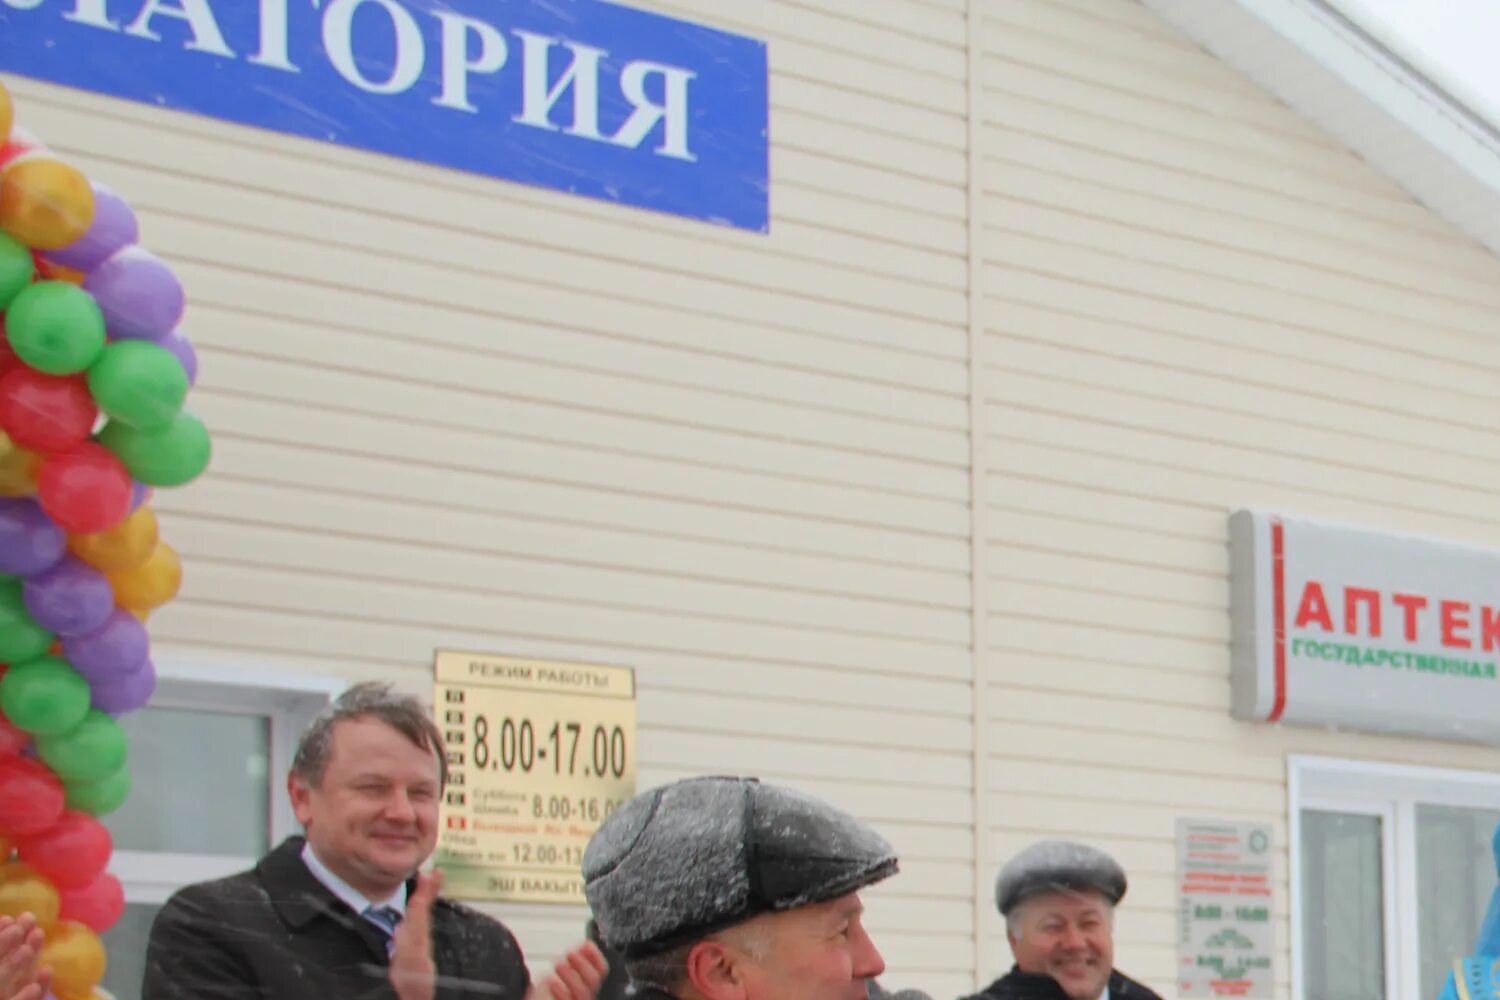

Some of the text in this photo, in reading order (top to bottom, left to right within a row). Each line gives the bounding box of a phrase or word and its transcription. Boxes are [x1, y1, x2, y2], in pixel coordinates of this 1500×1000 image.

[469, 662, 609, 687] РЕЖИМ РАБОТЫ
[1291, 638, 1497, 679] ГОСУДАРСТВЕННАЯ
[473, 714, 626, 779] 8.00-17.00
